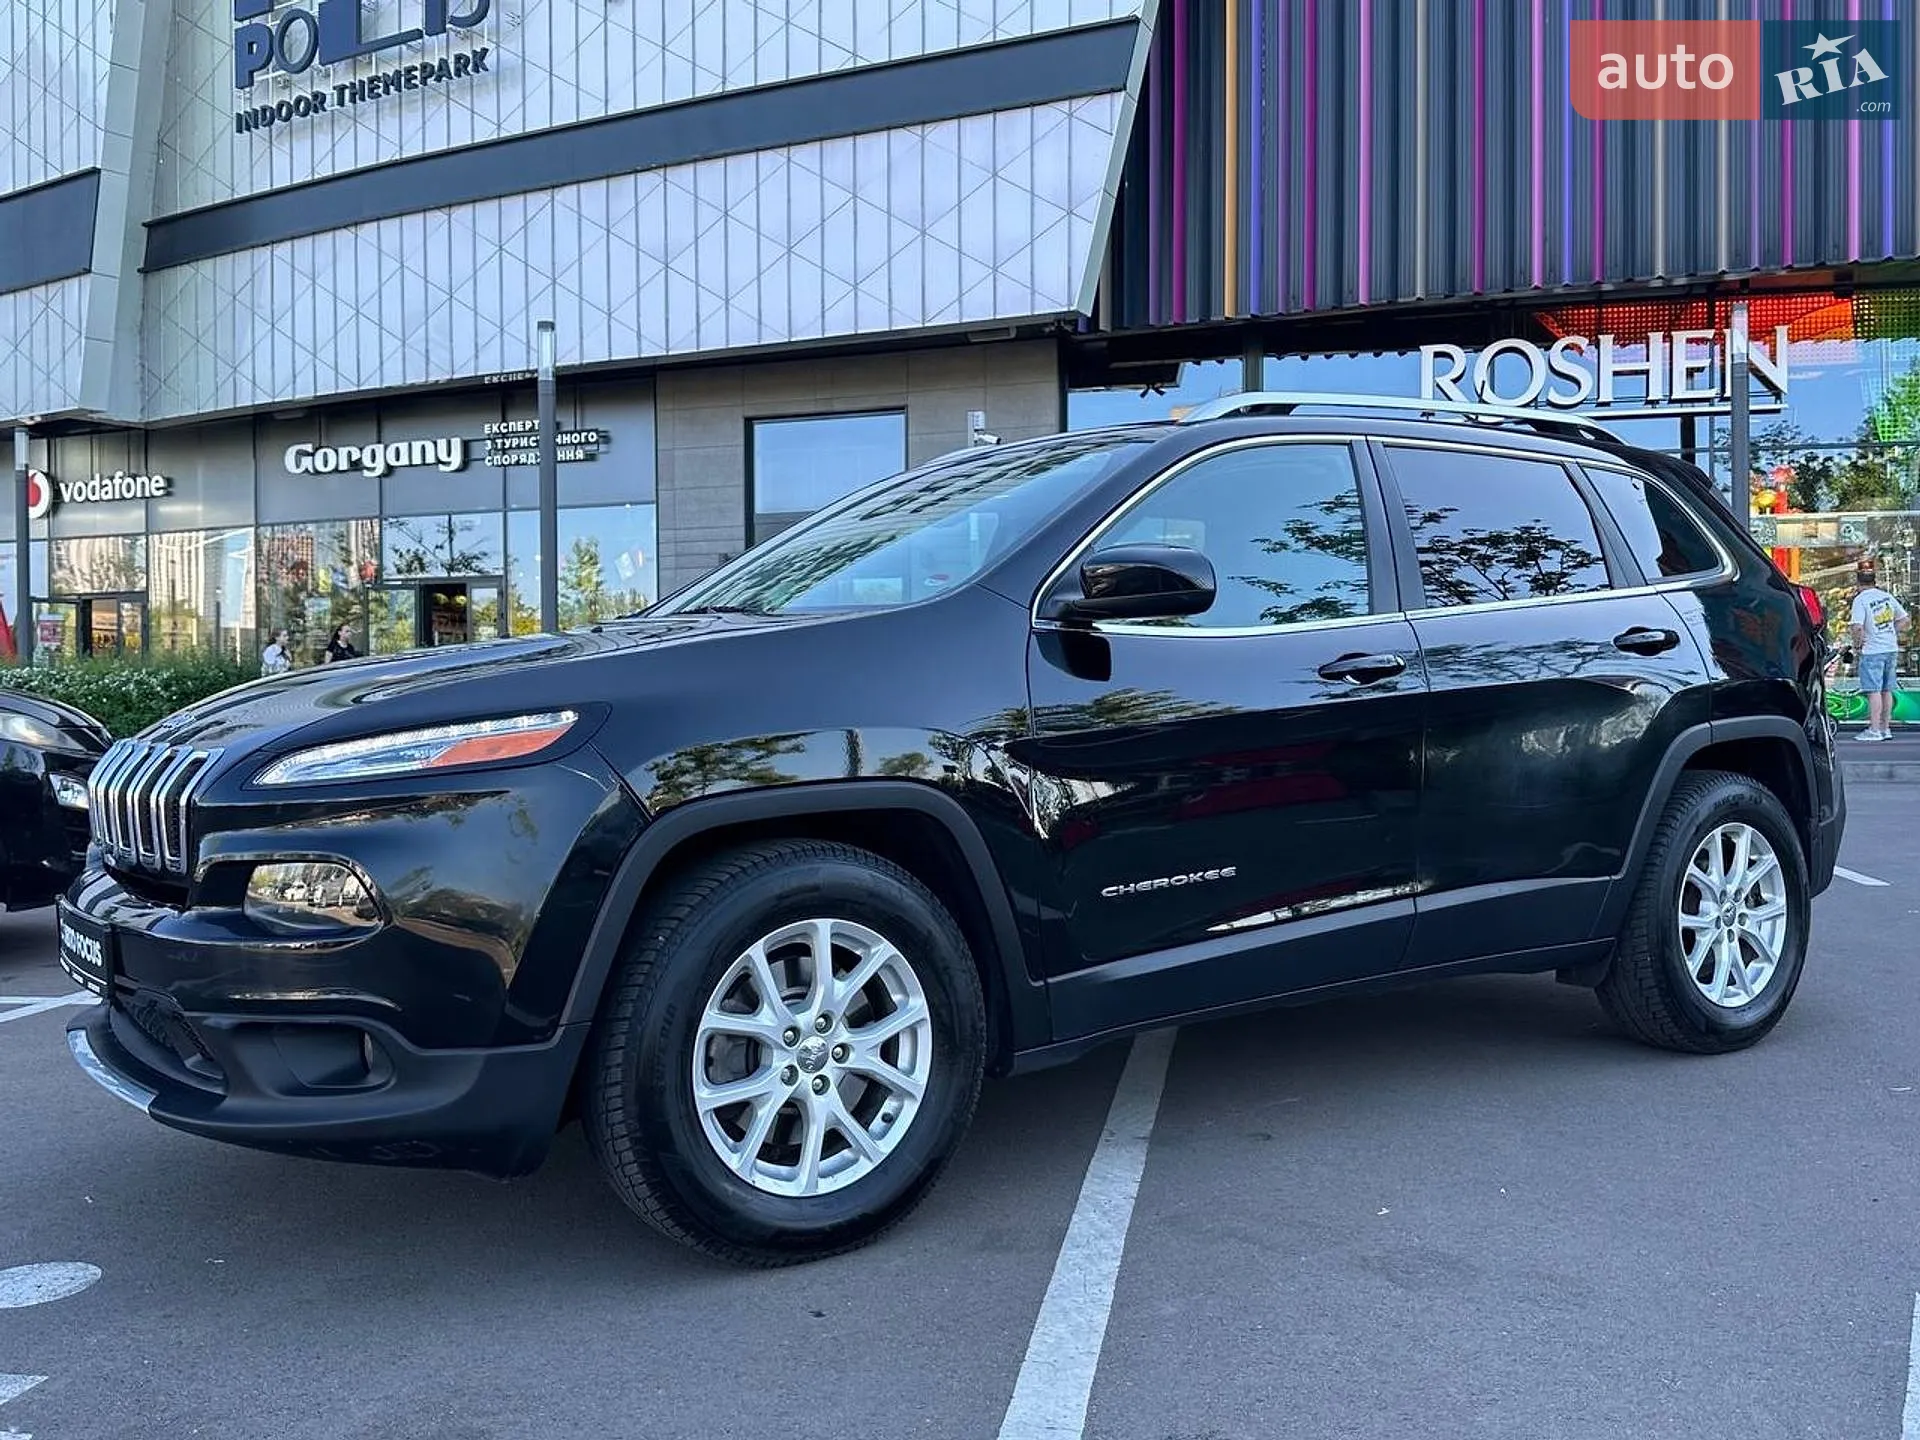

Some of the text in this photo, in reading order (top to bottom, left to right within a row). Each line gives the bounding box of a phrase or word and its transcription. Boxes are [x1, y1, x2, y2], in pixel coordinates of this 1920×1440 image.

[235, 47, 490, 134] INDOOR THEMEPARK
[1418, 324, 1792, 408] ROSHEN
[284, 437, 462, 477] Gorgany
[59, 471, 168, 503] vodafone
[1100, 866, 1237, 897] CHEROKEE
